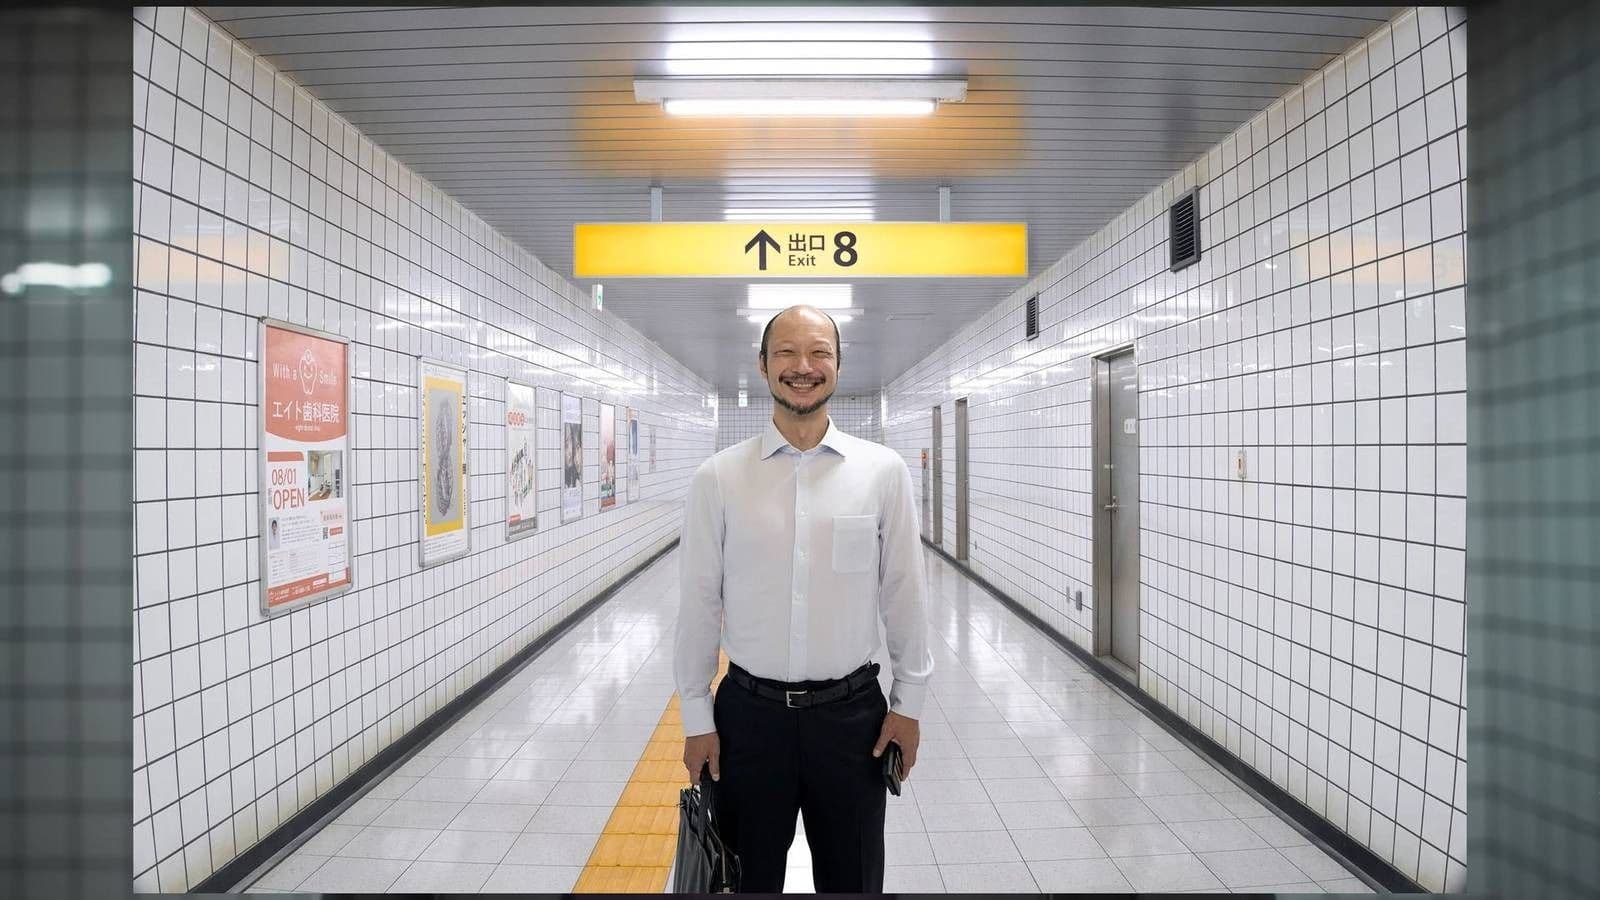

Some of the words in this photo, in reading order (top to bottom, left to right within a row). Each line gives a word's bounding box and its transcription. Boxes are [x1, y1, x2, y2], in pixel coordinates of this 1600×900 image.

[788, 233, 825, 252] 出口
[833, 231, 858, 267] 8
[788, 254, 816, 267] Exit
[272, 362, 290, 380] With
[319, 370, 338, 385] Smile
[272, 400, 340, 424] エイト歯科医院
[271, 467, 297, 486] 08/01
[273, 487, 305, 510] OPEN
